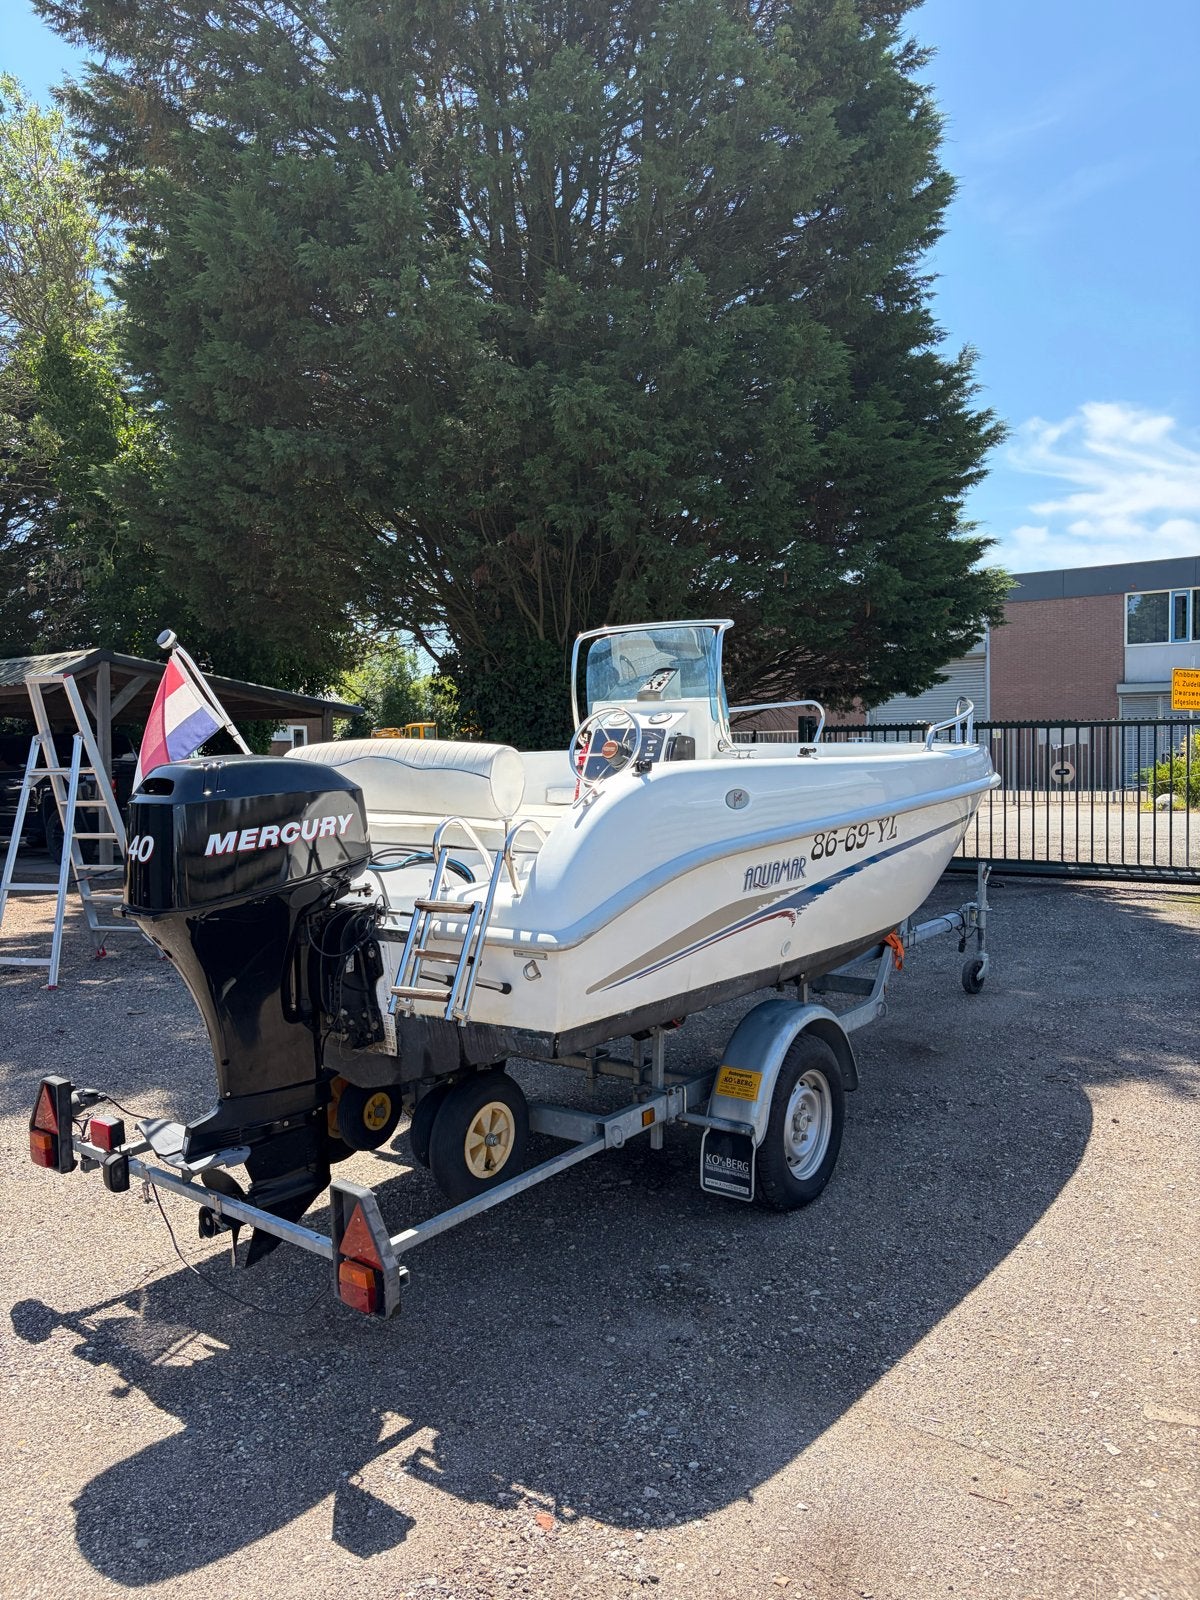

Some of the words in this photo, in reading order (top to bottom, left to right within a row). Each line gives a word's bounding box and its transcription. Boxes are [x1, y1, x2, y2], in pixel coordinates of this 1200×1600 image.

[128, 835, 155, 863] 40
[204, 813, 354, 857] MERCURY
[810, 815, 898, 861] 86-69-YL
[742, 855, 807, 893] AQUAMAR
[726, 1157, 749, 1172] BERG
